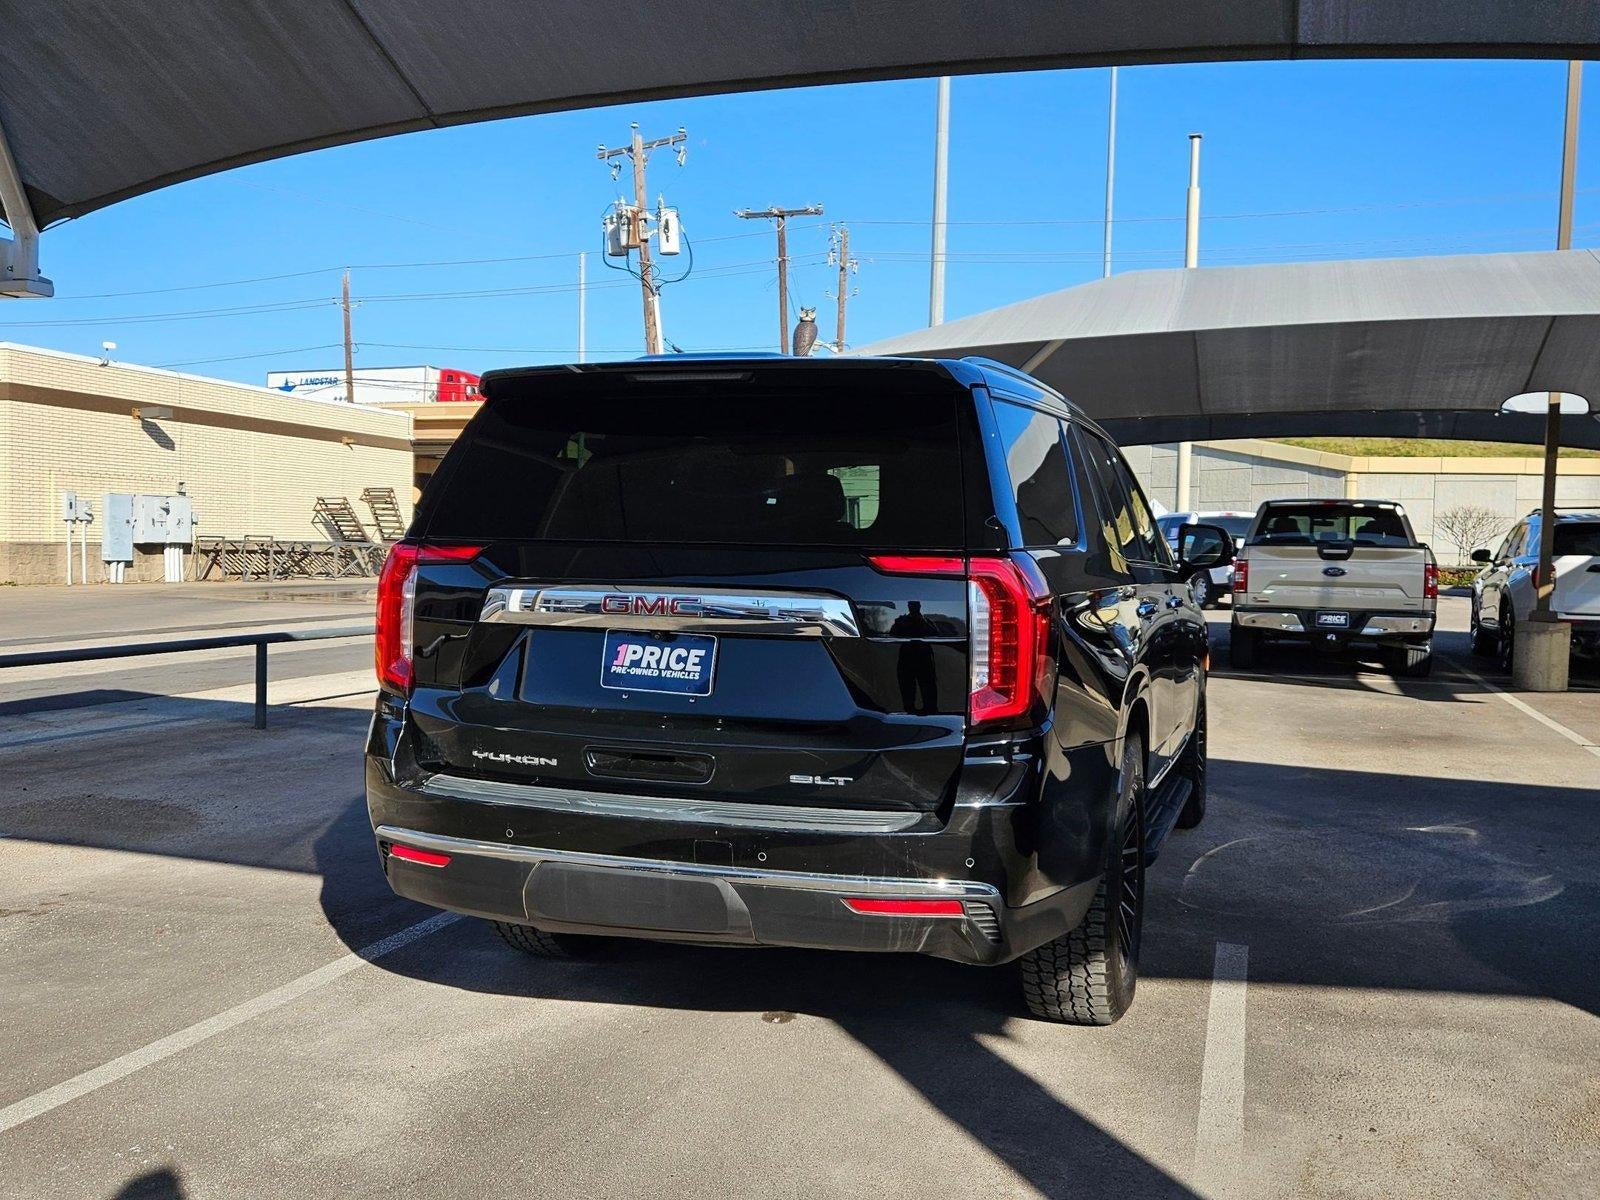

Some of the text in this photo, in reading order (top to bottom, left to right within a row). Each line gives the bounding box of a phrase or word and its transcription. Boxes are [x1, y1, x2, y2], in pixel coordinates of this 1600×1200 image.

[300, 376, 339, 386] LANDSTAR
[601, 594, 702, 617] GMC
[610, 665, 700, 680] PRE-OWNED VEHICLES
[472, 750, 558, 766] YUKON
[789, 774, 853, 786] SLT
